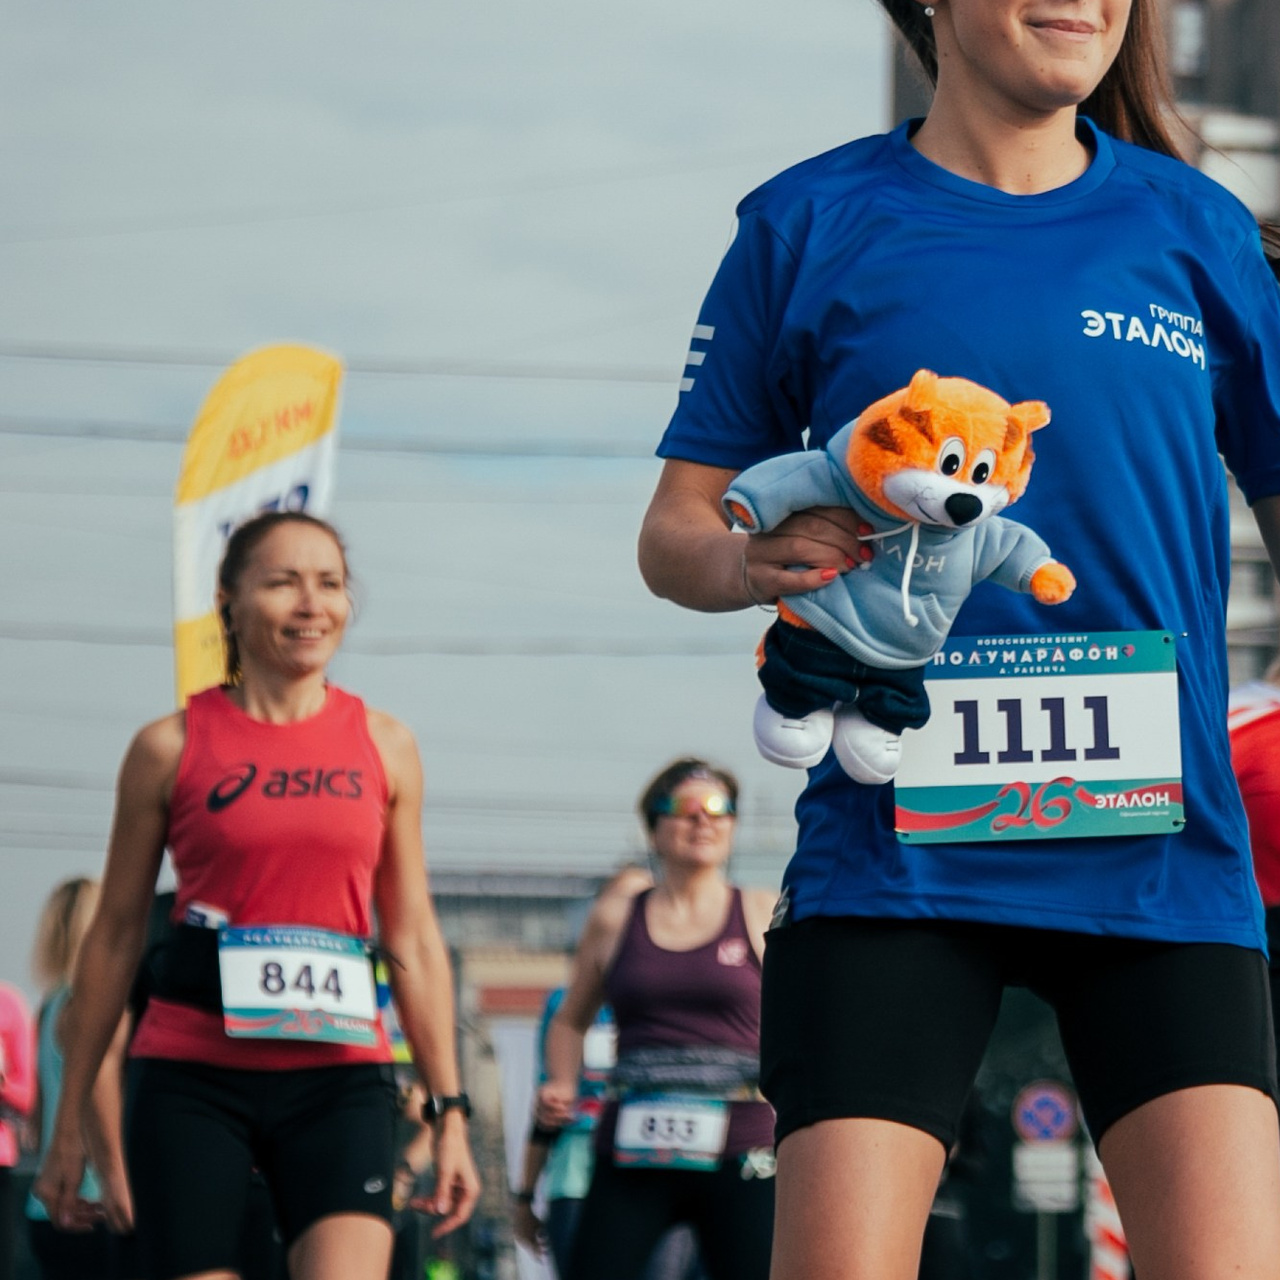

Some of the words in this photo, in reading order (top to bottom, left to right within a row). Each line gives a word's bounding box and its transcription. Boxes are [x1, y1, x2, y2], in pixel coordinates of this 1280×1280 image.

[1149, 303, 1204, 337] ГРУППА
[1081, 310, 1205, 370] ЭТАЛОН
[934, 645, 1118, 666] ПОЛУМАРАФОН
[953, 696, 1120, 765] 1111
[990, 776, 1076, 832] 26
[1094, 792, 1170, 809] ЭТАЛОН
[260, 962, 342, 1000] 844
